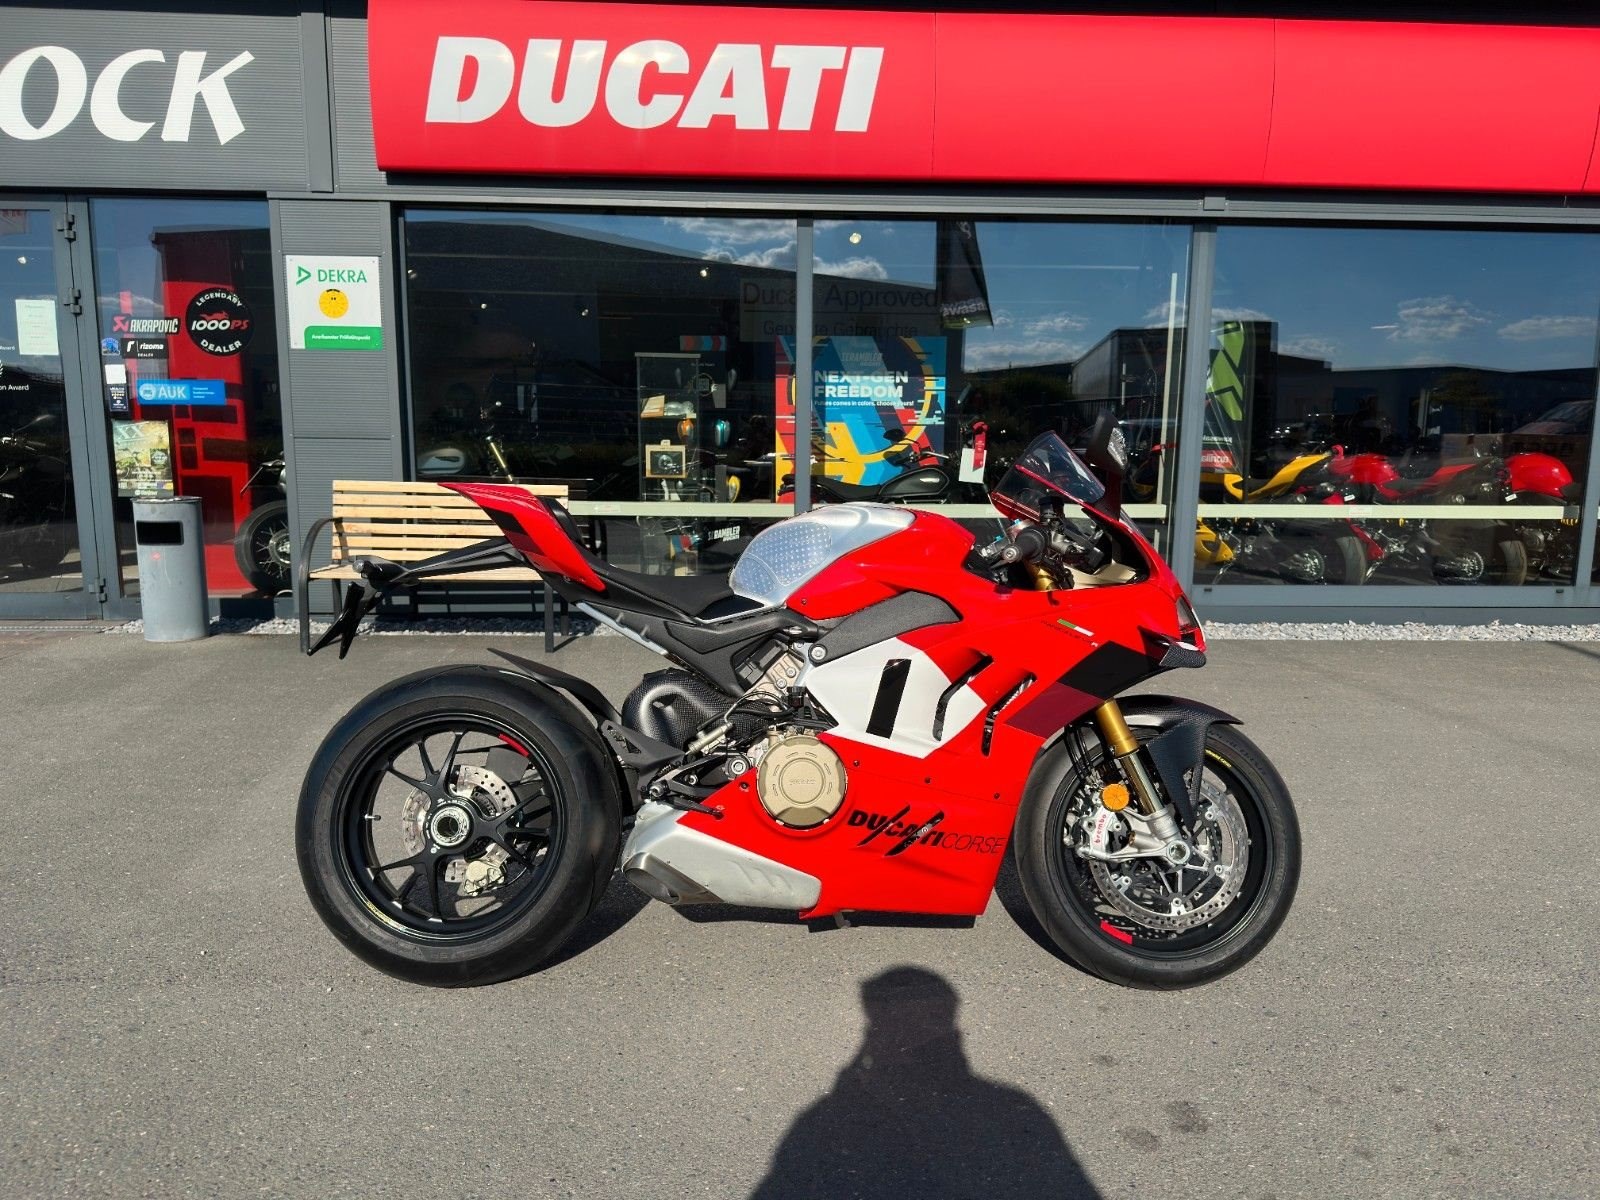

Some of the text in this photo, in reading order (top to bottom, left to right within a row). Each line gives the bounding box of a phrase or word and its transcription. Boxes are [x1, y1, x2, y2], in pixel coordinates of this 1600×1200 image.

[425, 36, 885, 133] DUCATI
[0, 45, 255, 146] OCK
[317, 269, 367, 283] DEKRA
[196, 291, 242, 307] LEGENDARY
[824, 285, 937, 311] Approved
[191, 319, 249, 331] 1000PS
[200, 339, 242, 353] DEALER
[814, 371, 909, 384] NEXT-GEN
[158, 386, 187, 399] AUK
[814, 385, 903, 398] FREEDOM
[1094, 814, 1107, 844] brembo
[941, 832, 1008, 855] CORSE
